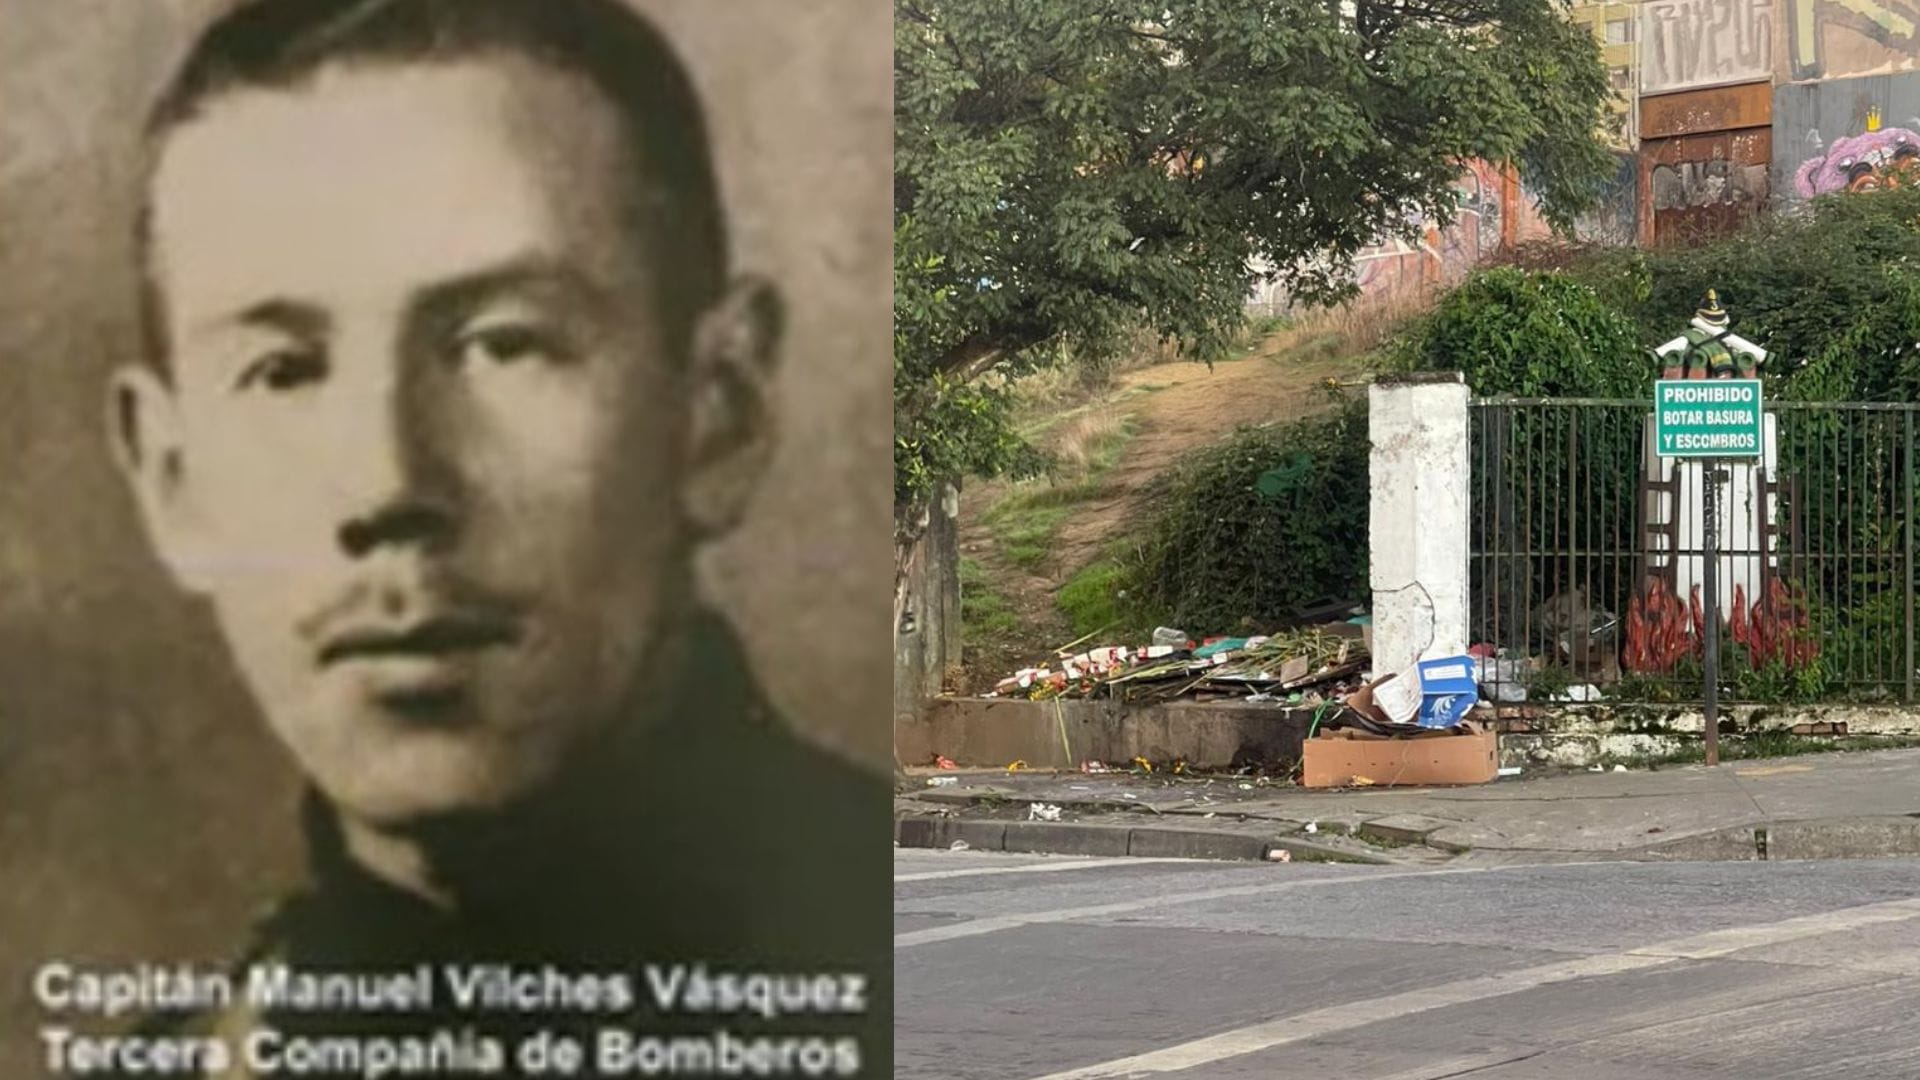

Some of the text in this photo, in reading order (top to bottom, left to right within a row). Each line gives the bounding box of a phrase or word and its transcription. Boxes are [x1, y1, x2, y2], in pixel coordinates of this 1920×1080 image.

[1663, 387, 1753, 403] PROHIBIDO
[1663, 410, 1754, 425] BOTAR BASURA
[1663, 433, 1755, 449] Y ESCOMBROS
